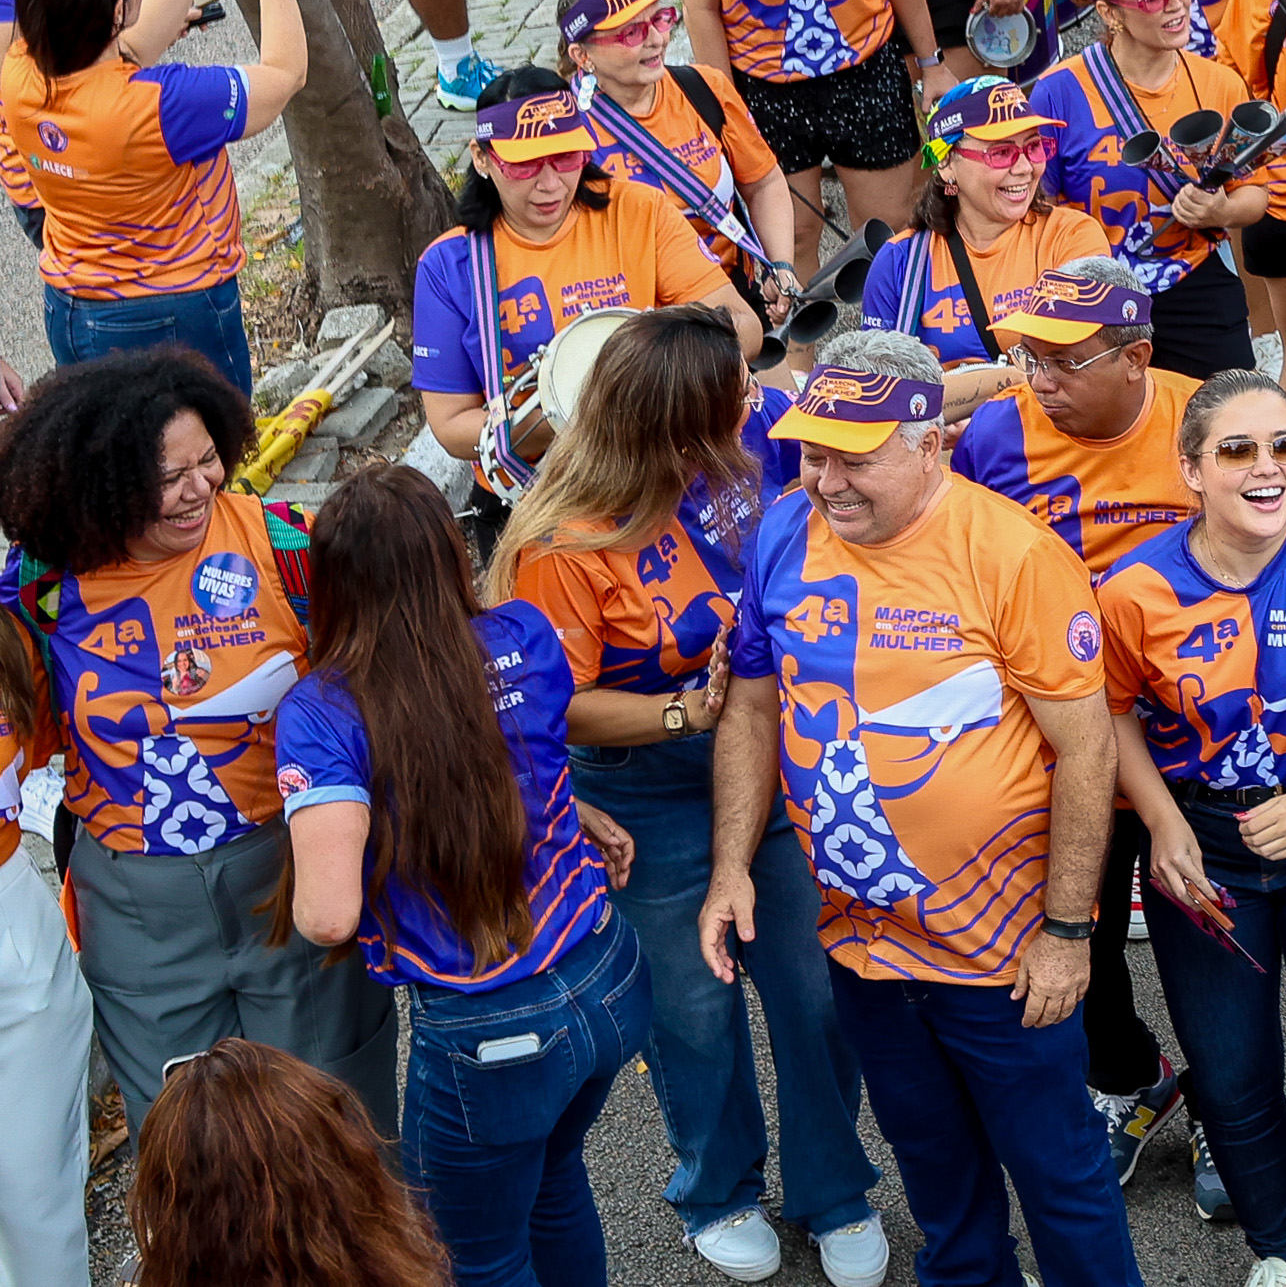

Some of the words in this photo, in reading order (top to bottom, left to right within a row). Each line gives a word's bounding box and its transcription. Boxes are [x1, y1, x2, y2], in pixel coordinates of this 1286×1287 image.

[569, 13, 588, 33] ALECE
[229, 77, 240, 108] ALECE
[940, 112, 964, 131] ALECE
[42, 159, 74, 179] ALECE
[561, 272, 626, 297] MARCHA
[1094, 511, 1178, 525] MULHER
[202, 565, 253, 588] MULHERES
[198, 575, 236, 599] VIVAS
[874, 607, 960, 628] MARCHA
[875, 621, 892, 631] em
[893, 622, 937, 634] defesa
[1271, 623, 1286, 631] em
[176, 628, 195, 638] em
[195, 623, 239, 636] defesa
[241, 619, 257, 630] da
[174, 630, 267, 651] MULHER
[869, 633, 963, 651] MULHER
